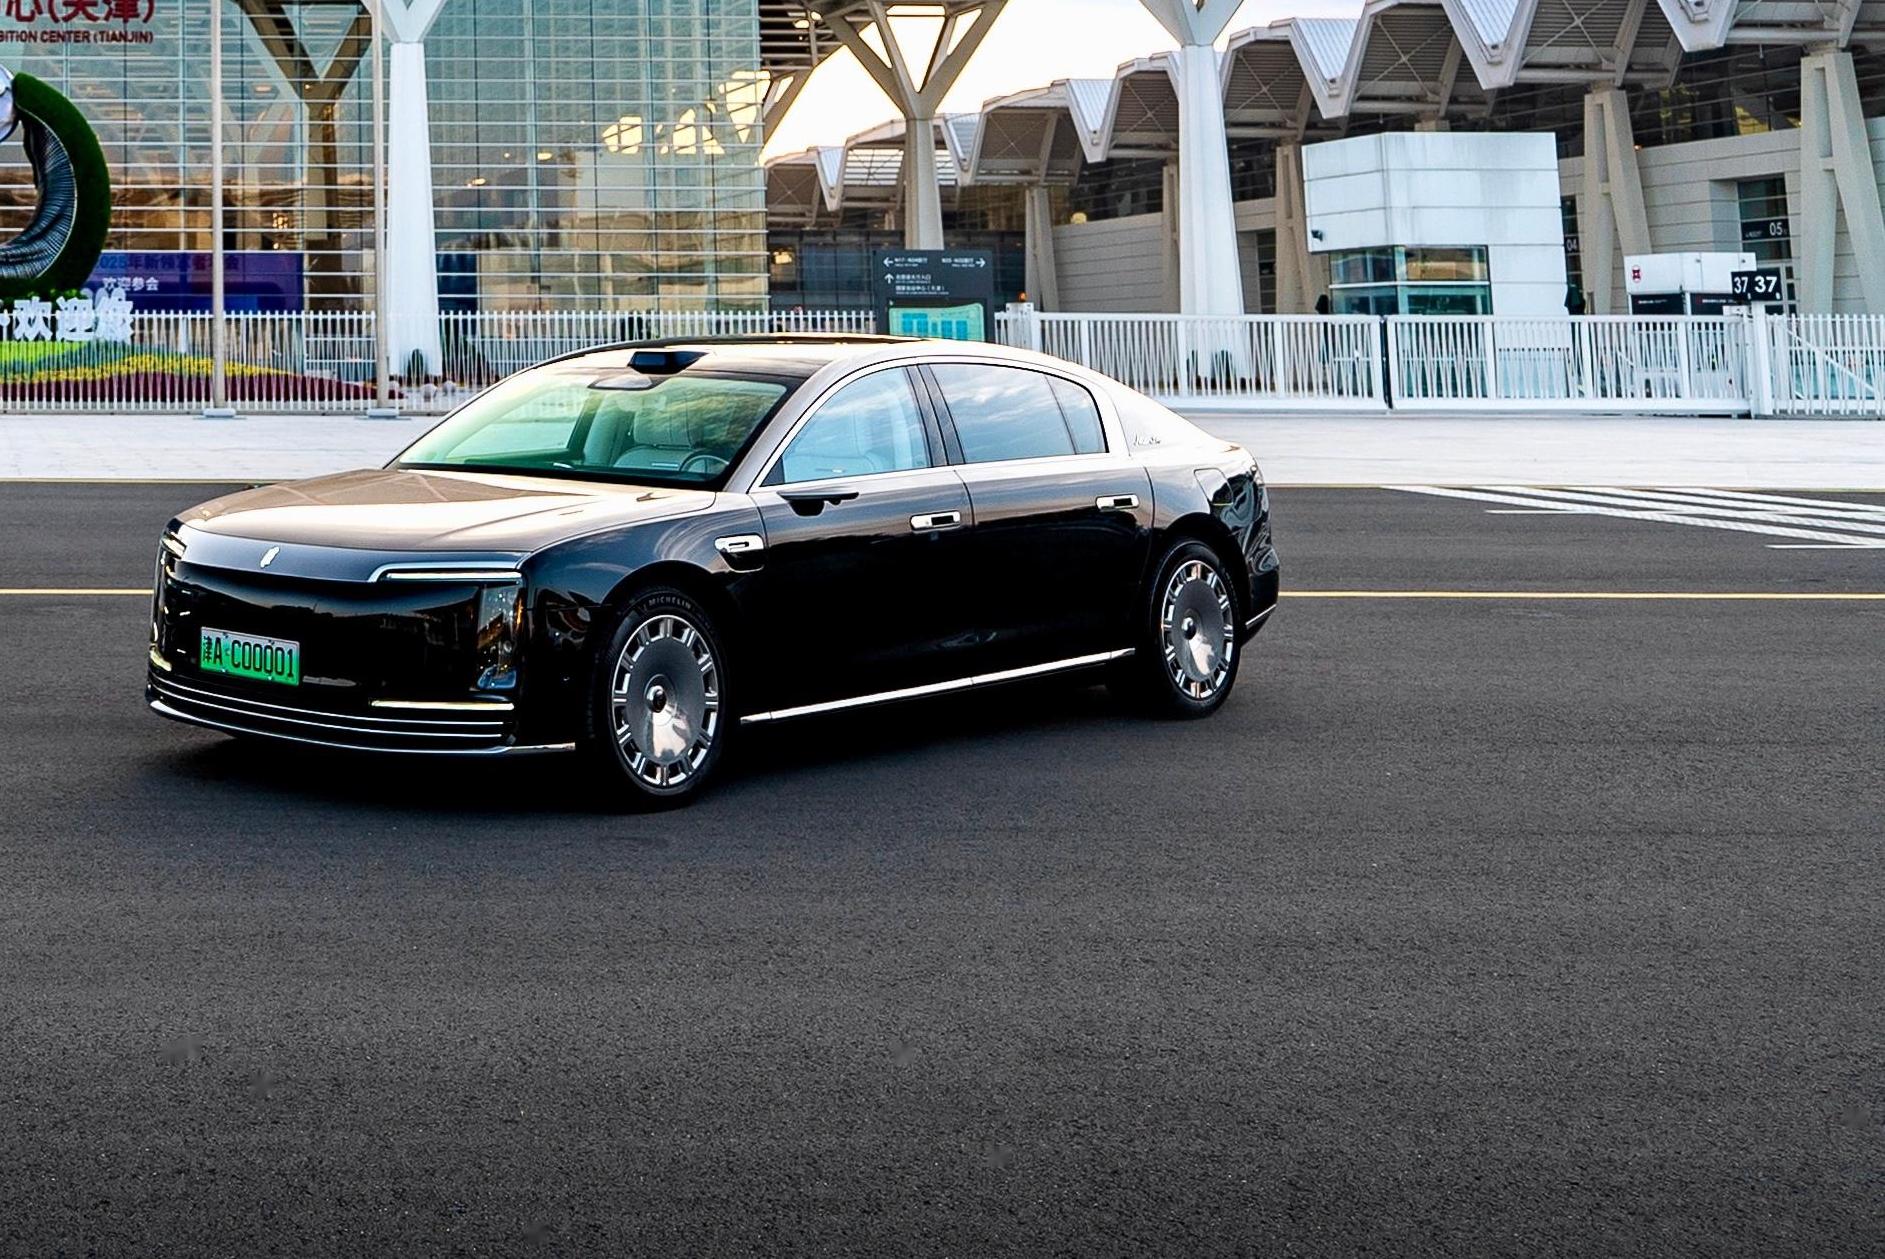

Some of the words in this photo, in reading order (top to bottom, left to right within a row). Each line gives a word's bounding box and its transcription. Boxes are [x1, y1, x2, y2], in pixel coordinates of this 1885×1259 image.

[40, 30, 90, 43] CENTER
[94, 30, 154, 44] (TIANJIN)
[1734, 276, 1749, 293] 37
[1754, 275, 1778, 293] 37
[648, 595, 692, 610] MICHELIN
